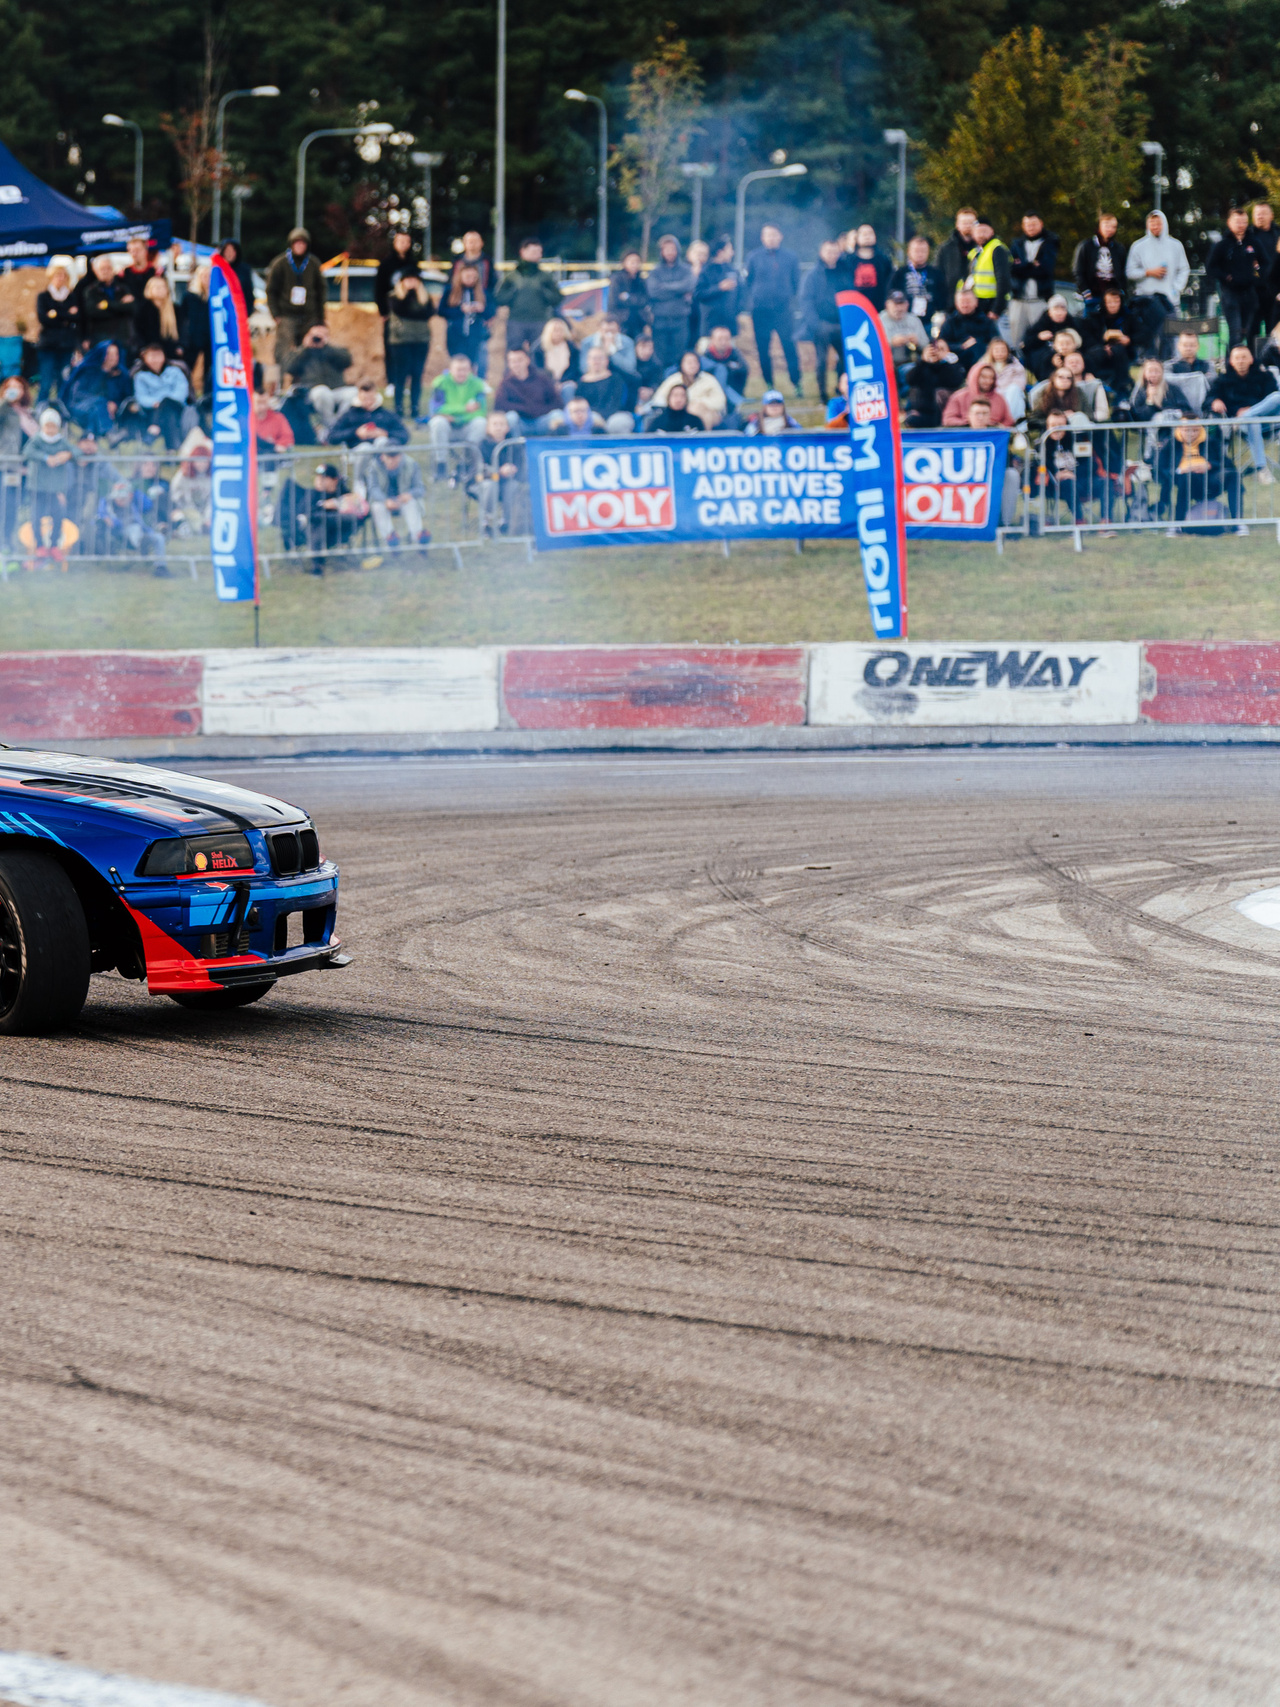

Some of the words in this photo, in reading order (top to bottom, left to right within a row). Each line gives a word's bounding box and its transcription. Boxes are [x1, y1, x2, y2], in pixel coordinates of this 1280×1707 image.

[548, 452, 665, 491] LIQUI
[681, 446, 783, 474] MOTOR
[786, 445, 853, 472] OILS
[904, 447, 987, 485] QUI
[692, 472, 844, 500] ADDITIVES
[551, 490, 671, 532] MOLY
[698, 500, 760, 526] CAR
[762, 498, 842, 524] CARE
[904, 485, 988, 524] OLY
[211, 851, 223, 859] Shell
[212, 855, 238, 869] HELIX
